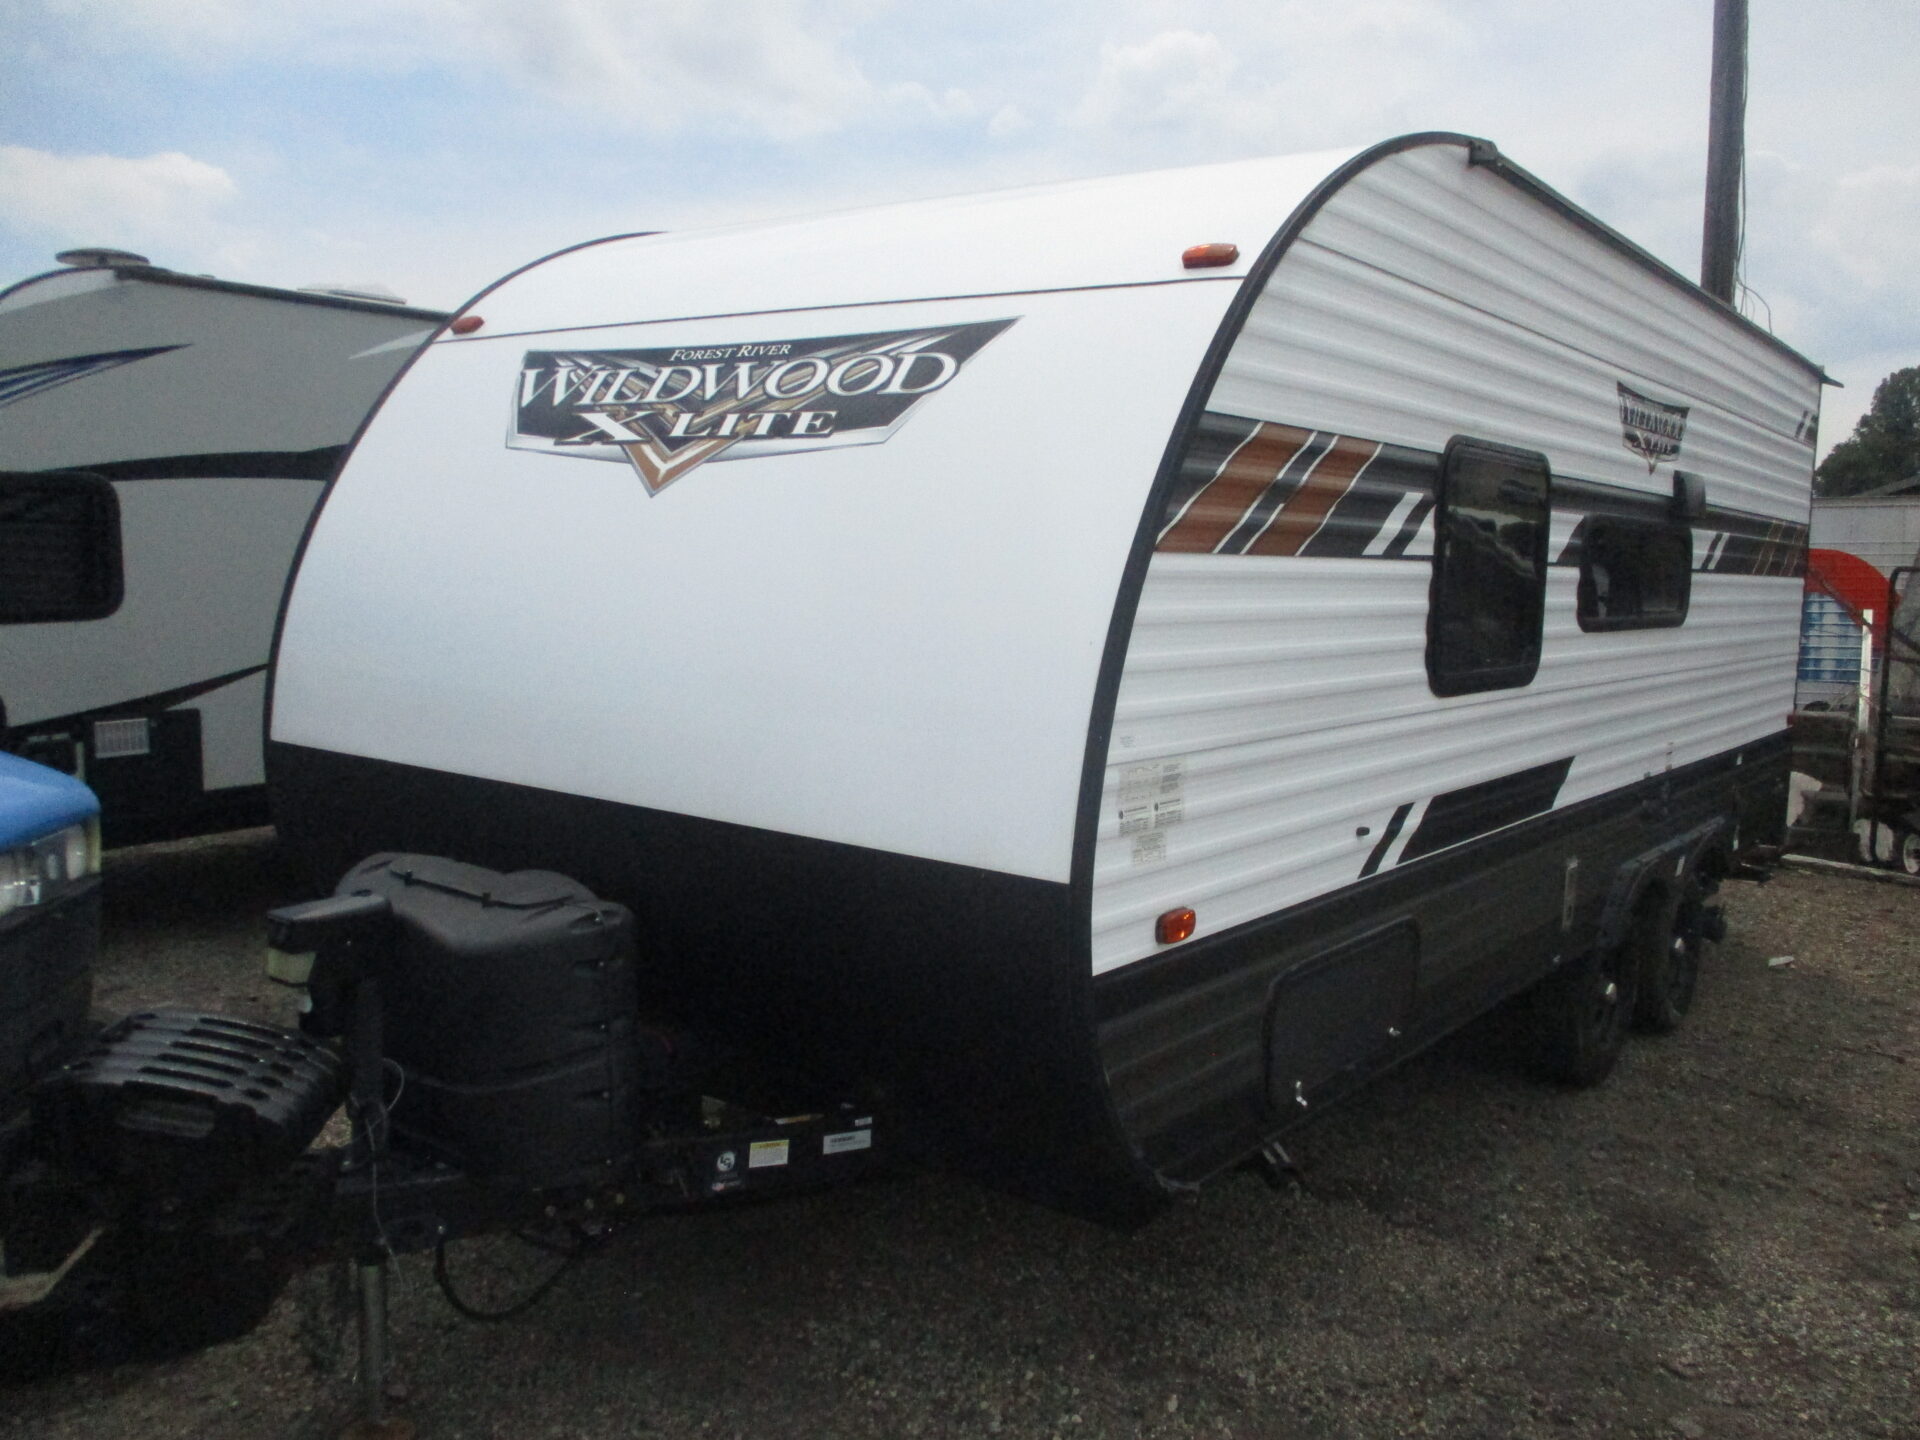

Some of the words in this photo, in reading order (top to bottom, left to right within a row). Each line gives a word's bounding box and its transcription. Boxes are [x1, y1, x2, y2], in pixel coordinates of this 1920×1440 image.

[670, 349, 736, 361] FOREST
[737, 344, 792, 358] RIVER
[520, 352, 957, 407] WILDWOOD
